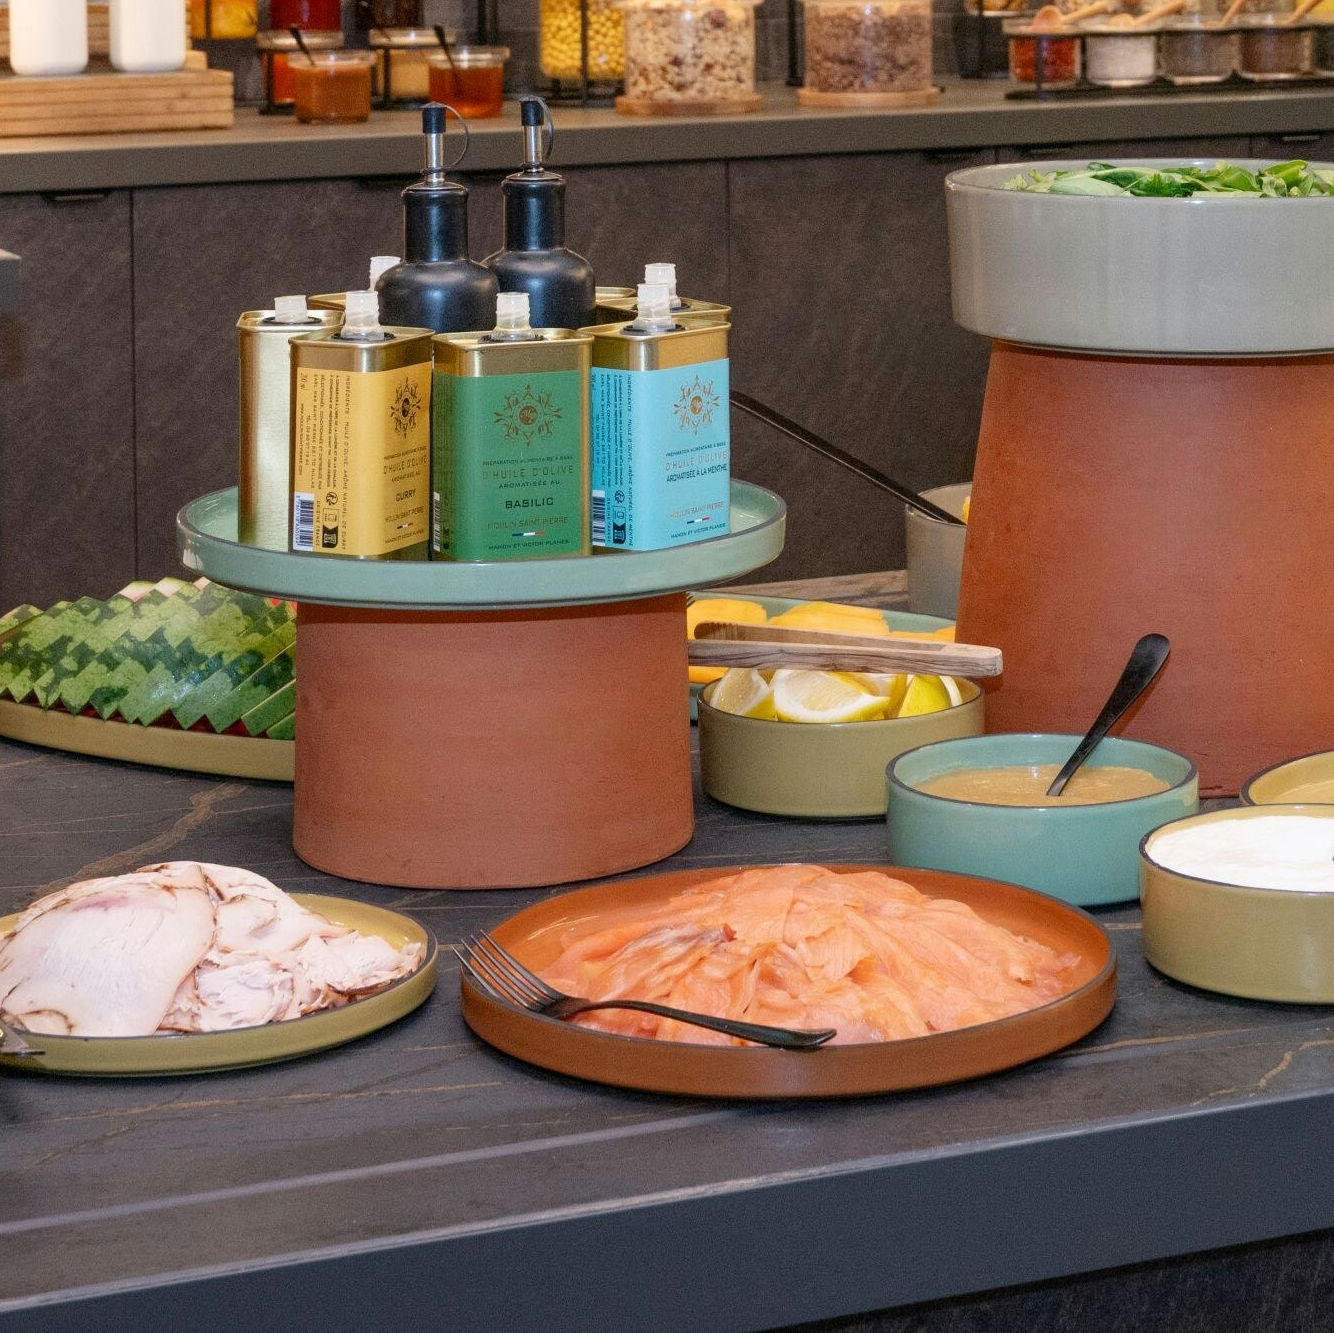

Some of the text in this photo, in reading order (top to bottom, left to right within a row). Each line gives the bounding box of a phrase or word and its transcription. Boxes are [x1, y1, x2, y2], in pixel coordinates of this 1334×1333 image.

[666, 450, 727, 471] D'HUILE D'OLIVE
[482, 465, 574, 480] D'HUILE D'OLIVE
[667, 468, 696, 483] AROMATISÉE
[700, 468, 707, 476] LA
[708, 463, 728, 474] MENTHE
[499, 480, 547, 489] AROMATISÉE
[395, 488, 417, 502] CURRY
[505, 497, 554, 509] BASILIC
[488, 516, 568, 530] MOULIN SAINT PIERRE
